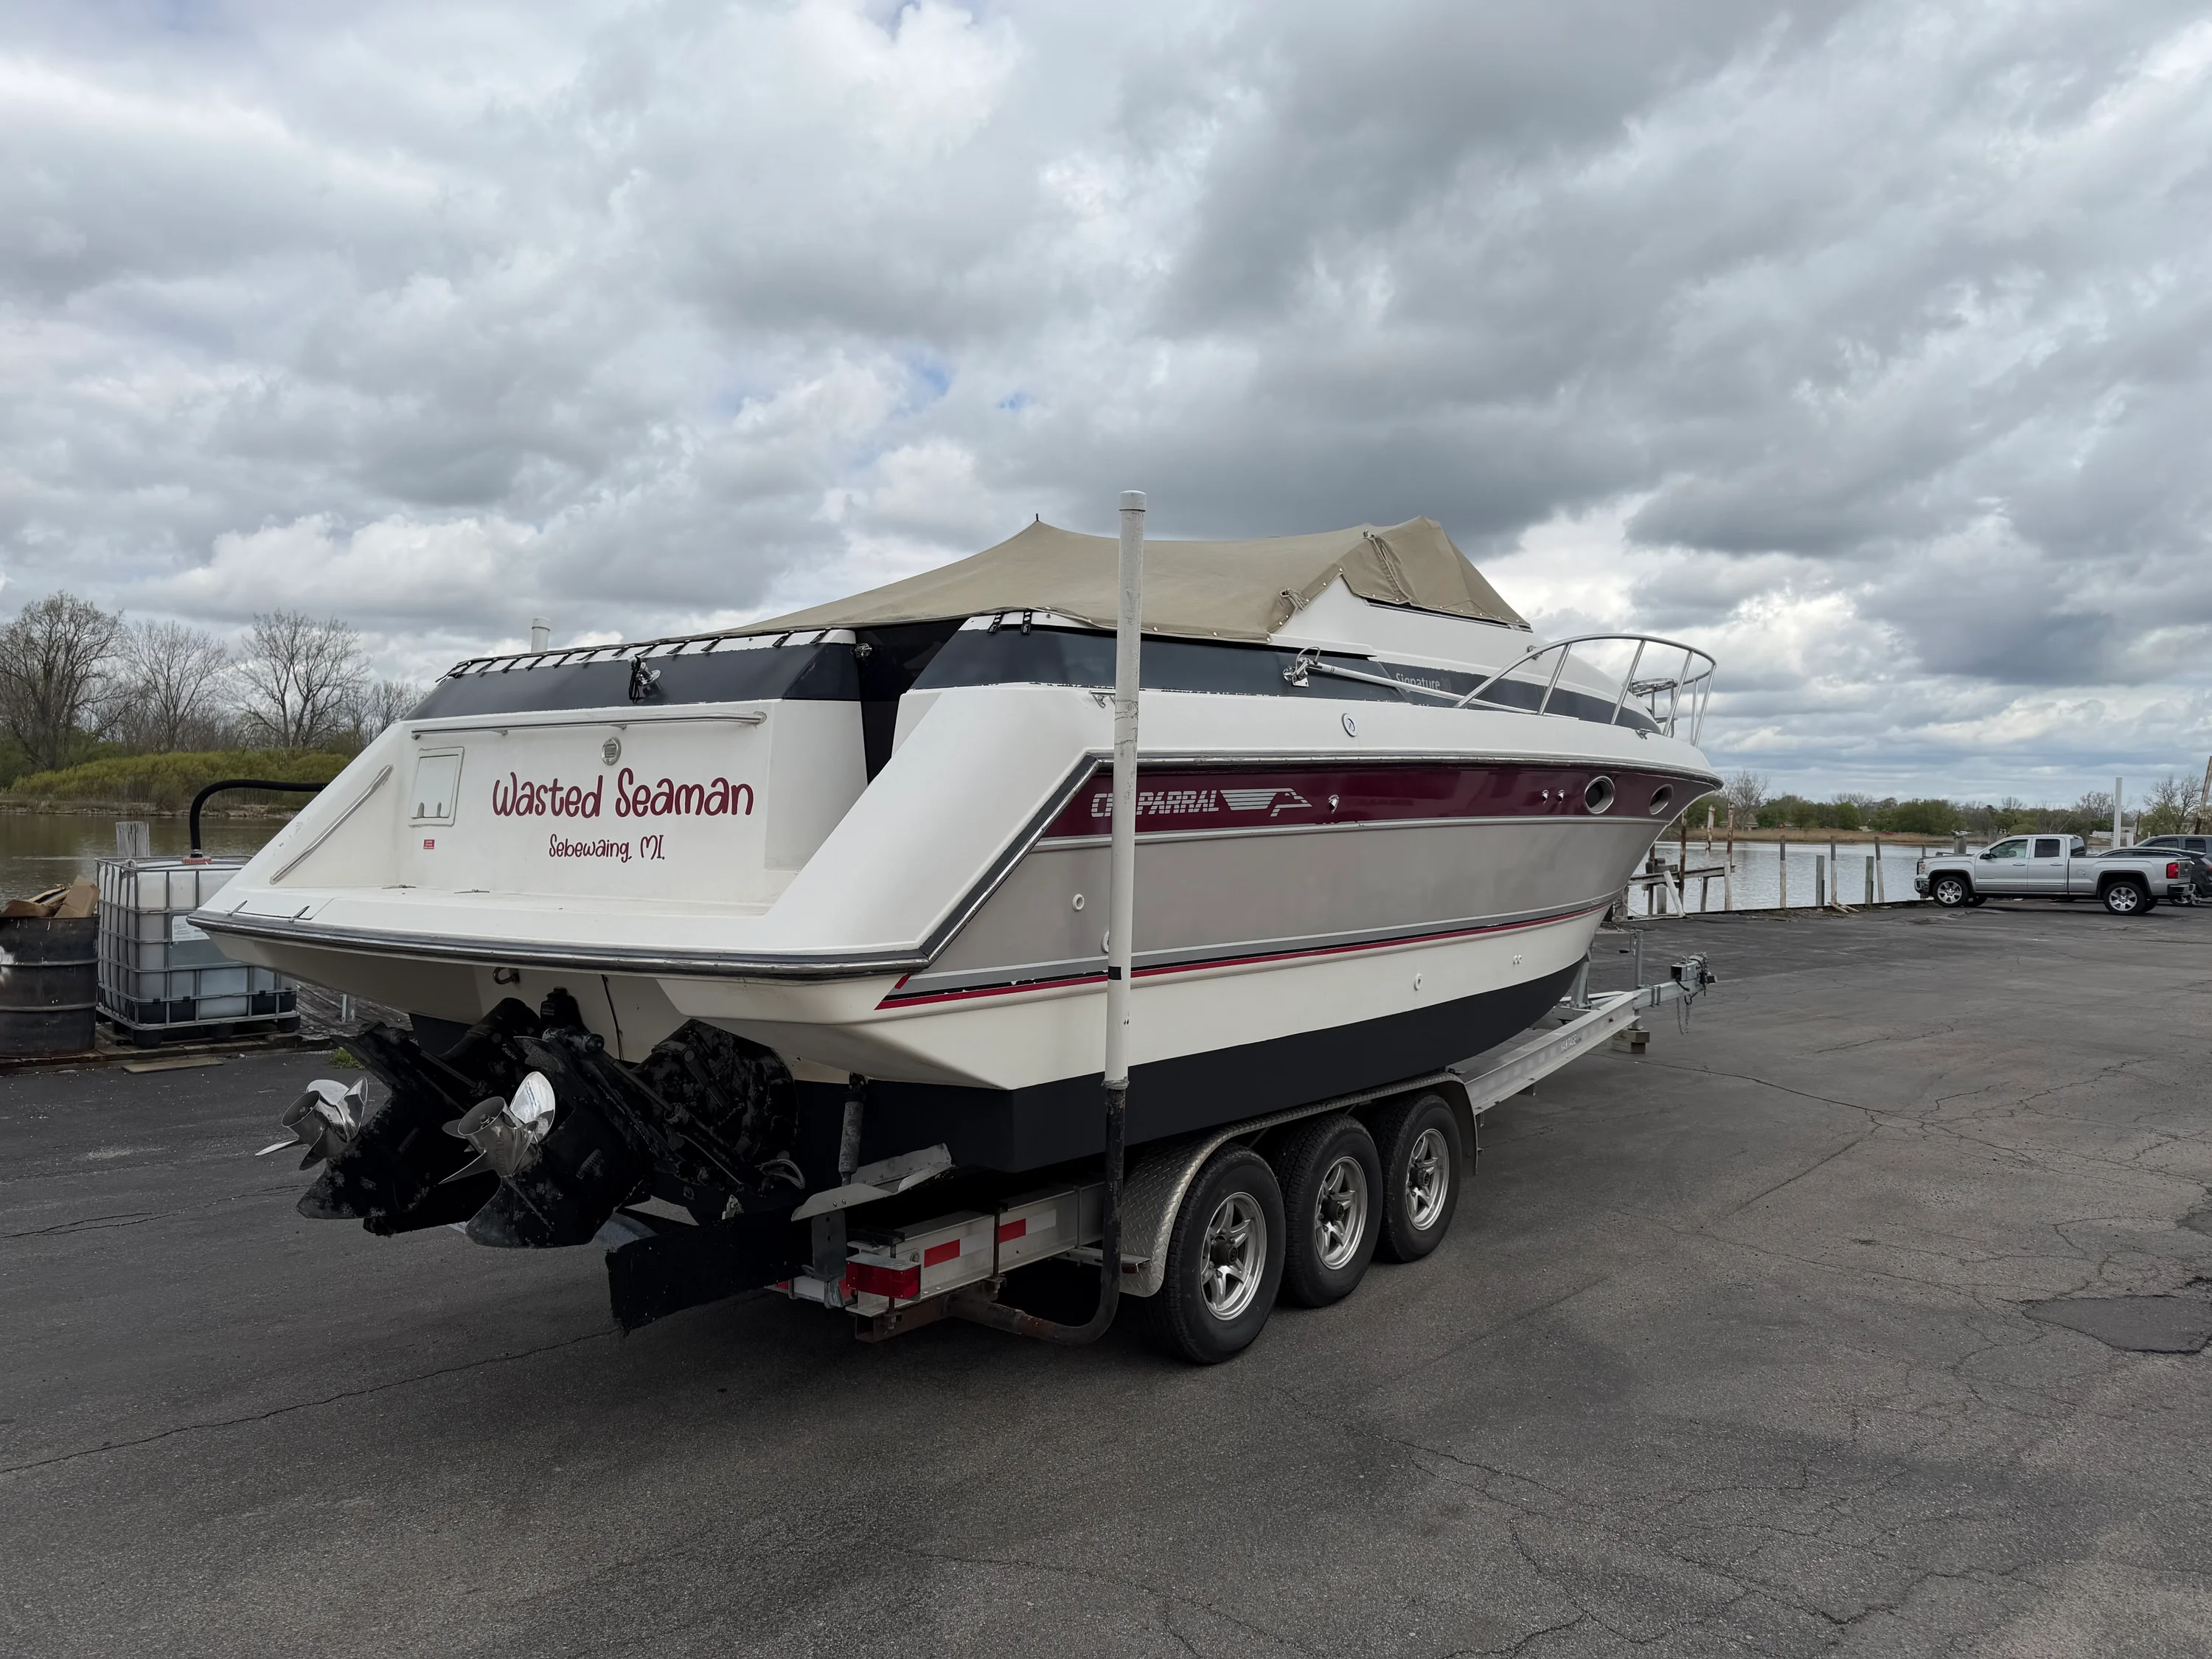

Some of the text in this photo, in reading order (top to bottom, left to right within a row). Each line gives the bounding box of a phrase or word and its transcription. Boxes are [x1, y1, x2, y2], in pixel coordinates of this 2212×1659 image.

[493, 767, 754, 818] Wasted Seaman
[1091, 790, 1220, 818] CPARRAL
[549, 833, 665, 863] Sebewaing, MI.
